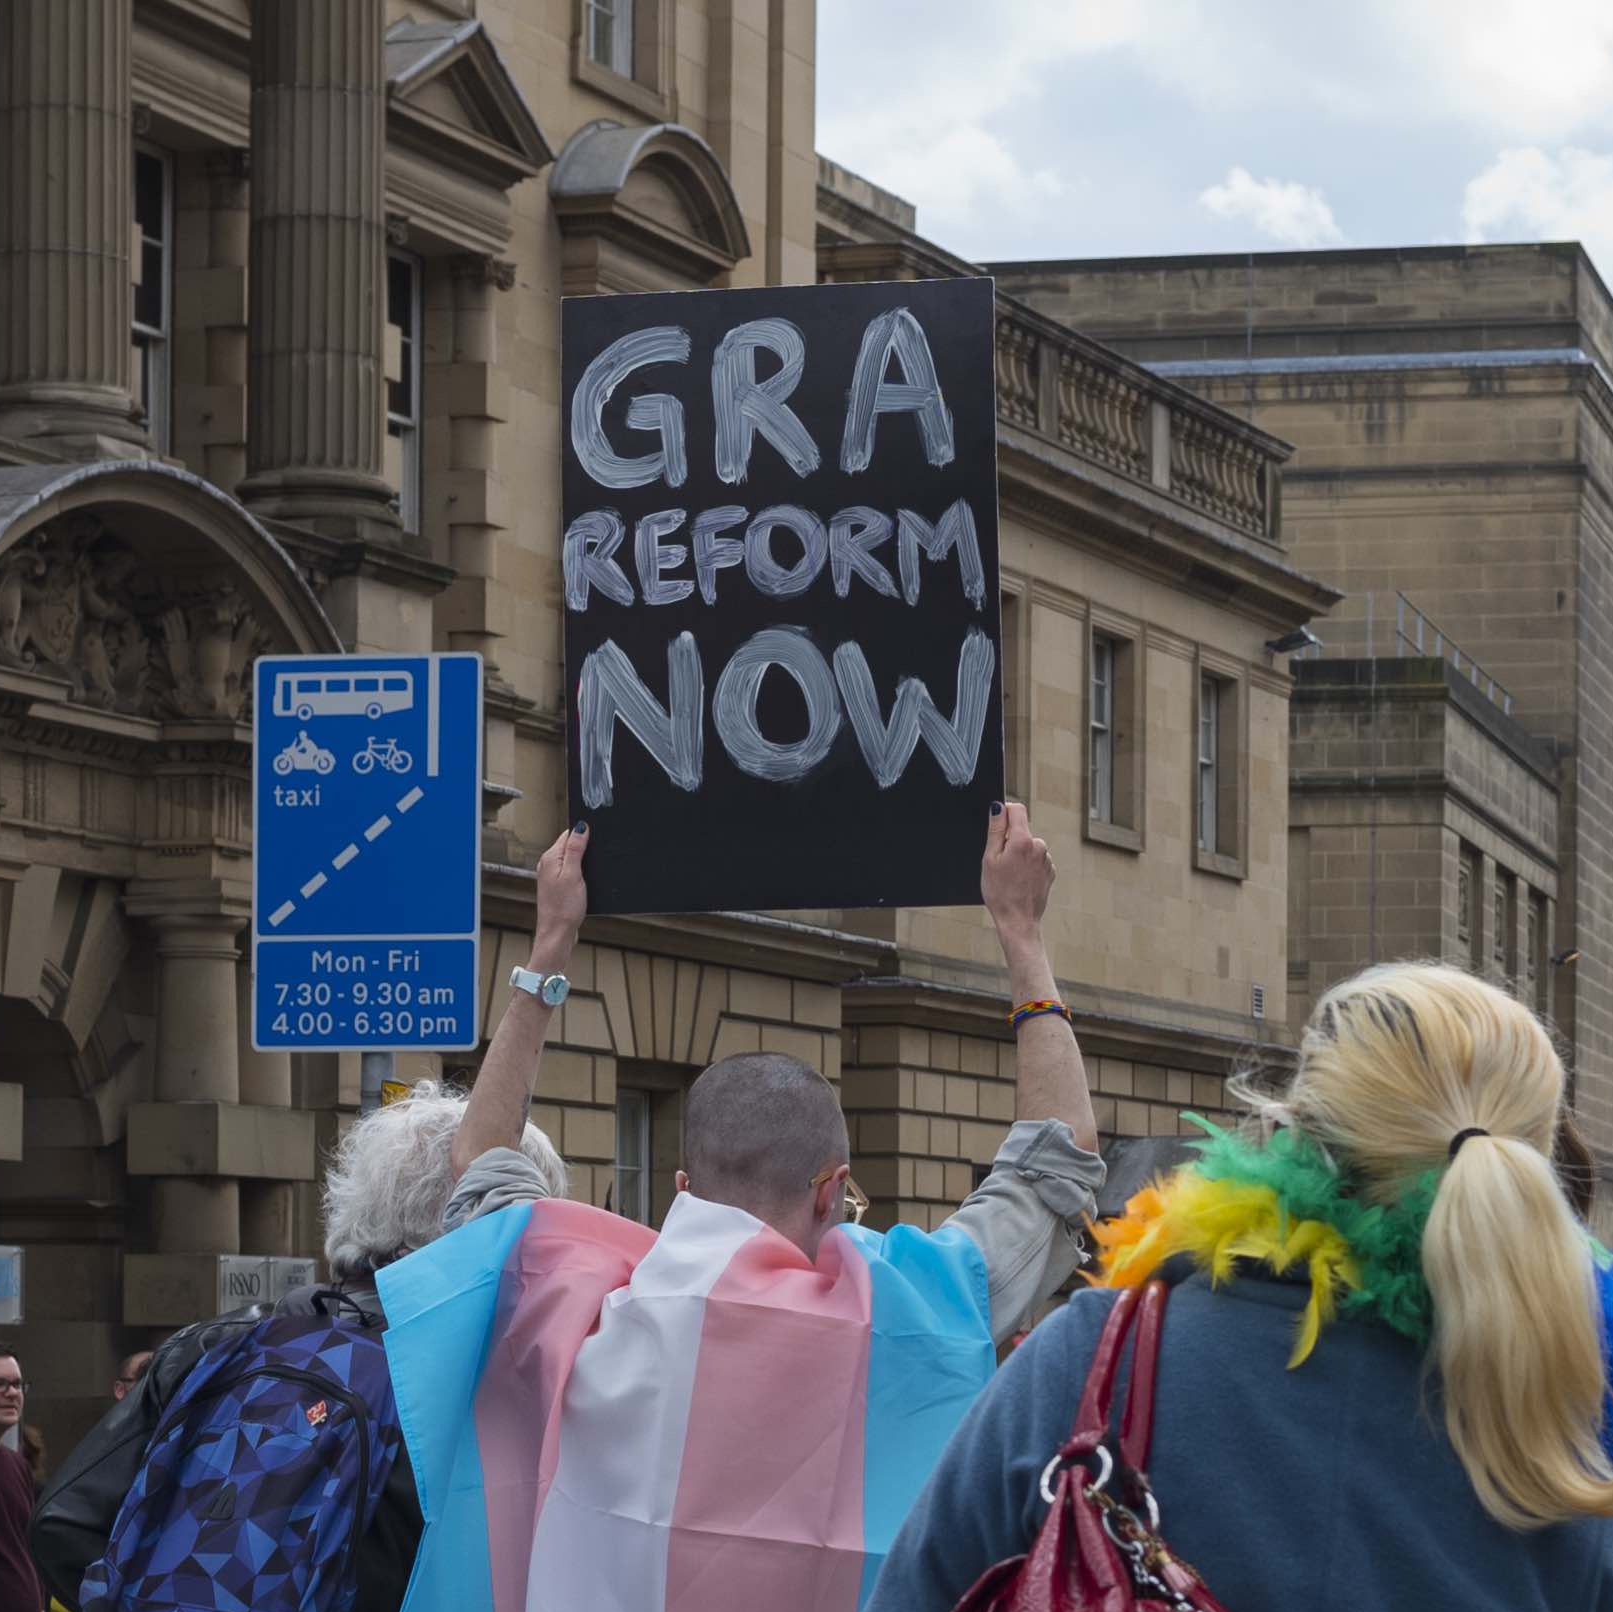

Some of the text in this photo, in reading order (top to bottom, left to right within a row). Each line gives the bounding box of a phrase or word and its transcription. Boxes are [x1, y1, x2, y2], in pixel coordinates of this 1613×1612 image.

[570, 307, 956, 489] GRA
[563, 498, 987, 612] REFORM
[577, 625, 996, 808] NOW
[273, 786, 321, 806] taxi
[311, 950, 365, 972] Mon
[388, 950, 420, 972] Fri
[274, 983, 331, 1006] 7.30
[352, 982, 411, 1005] 9.30
[418, 987, 454, 1004] am
[272, 1012, 333, 1035] 4.00
[354, 1012, 413, 1035] 6.30
[420, 1017, 457, 1038] pm
